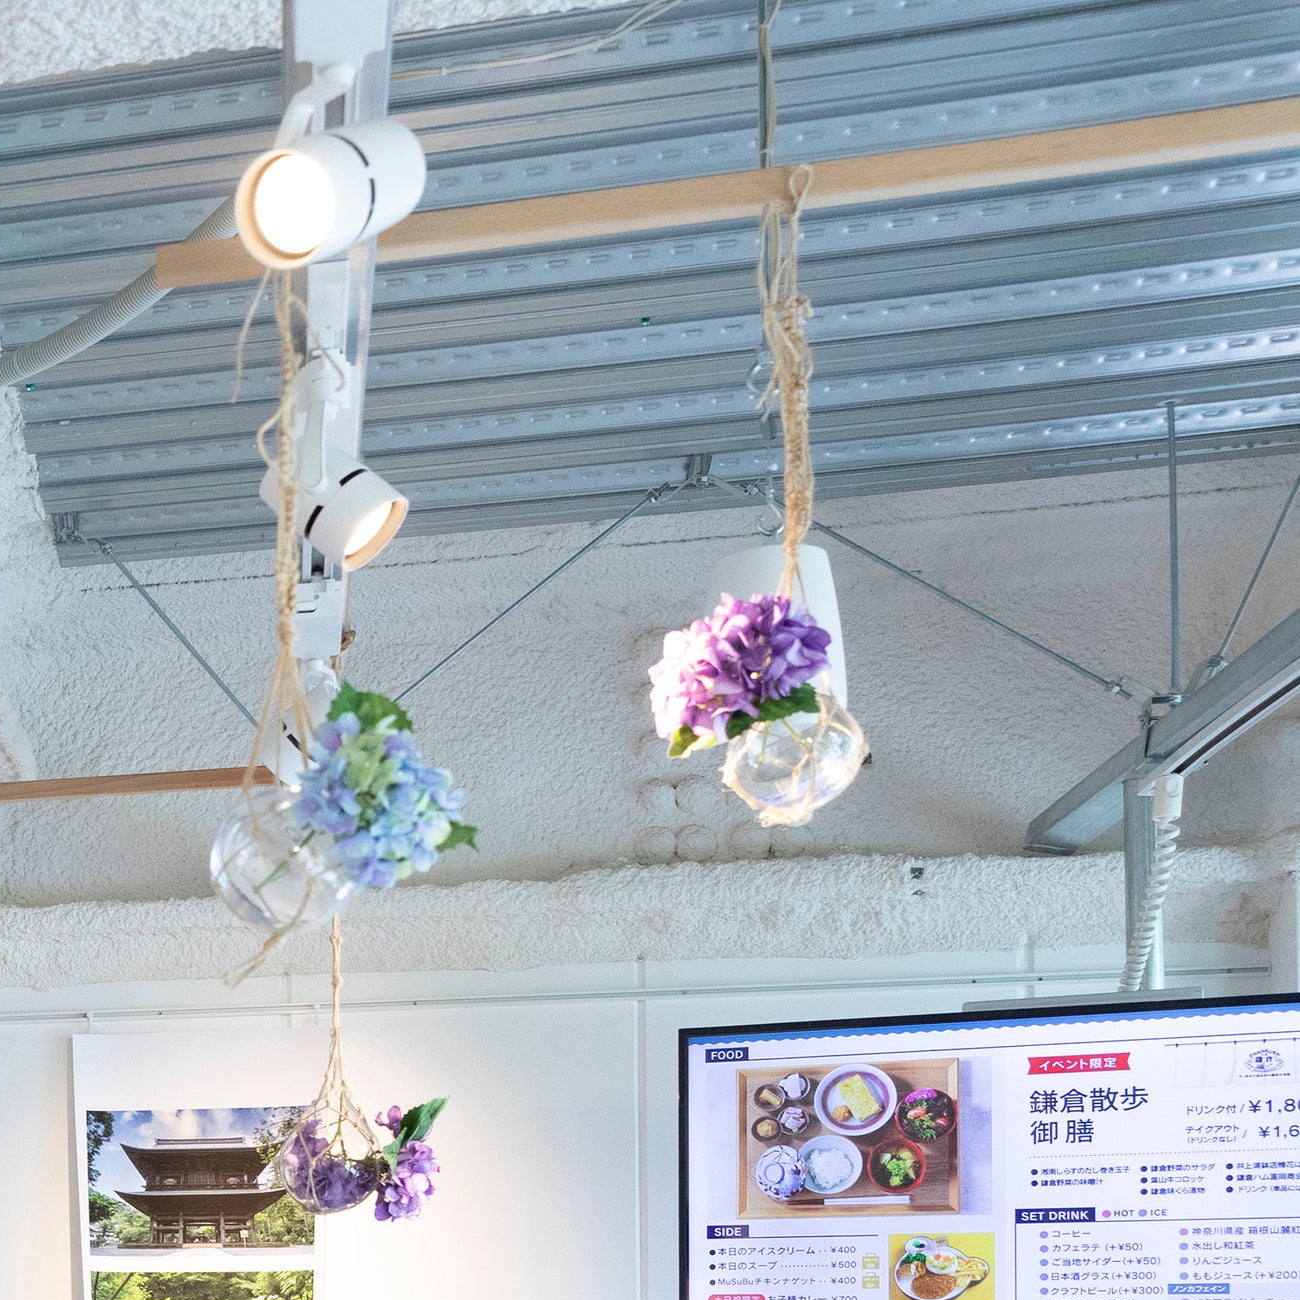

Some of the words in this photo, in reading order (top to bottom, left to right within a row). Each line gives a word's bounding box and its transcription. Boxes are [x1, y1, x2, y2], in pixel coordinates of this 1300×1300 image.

[711, 1050, 744, 1060] FOOD
[1039, 1057, 1118, 1071] イベント限定
[1029, 1085, 1149, 1115] 鎌倉散歩
[1248, 1098, 1300, 1113] ¥1,8
[1021, 1211, 1045, 1221] SET
[1049, 1210, 1089, 1221] DRINK
[1113, 1209, 1135, 1217] HOT
[1150, 1209, 1168, 1217] ICE
[714, 1227, 742, 1237] SIDE
[1052, 1230, 1091, 1238] コーヒー
[1191, 1227, 1244, 1236] 神奈川県産
[718, 1247, 816, 1256] 本日のアイスクリーム
[831, 1245, 857, 1254] ¥400
[1052, 1243, 1100, 1252] カフェラテ
[1192, 1241, 1255, 1251] 水出し和紅茶
[718, 1261, 778, 1271] 本日のスープ
[831, 1260, 857, 1269] ¥500
[1193, 1256, 1262, 1265] りんごジュース
[718, 1277, 816, 1286] MuSuBuチキンナゲット
[831, 1276, 857, 1285] ¥400
[1172, 1285, 1226, 1293] ノンカフェイン
